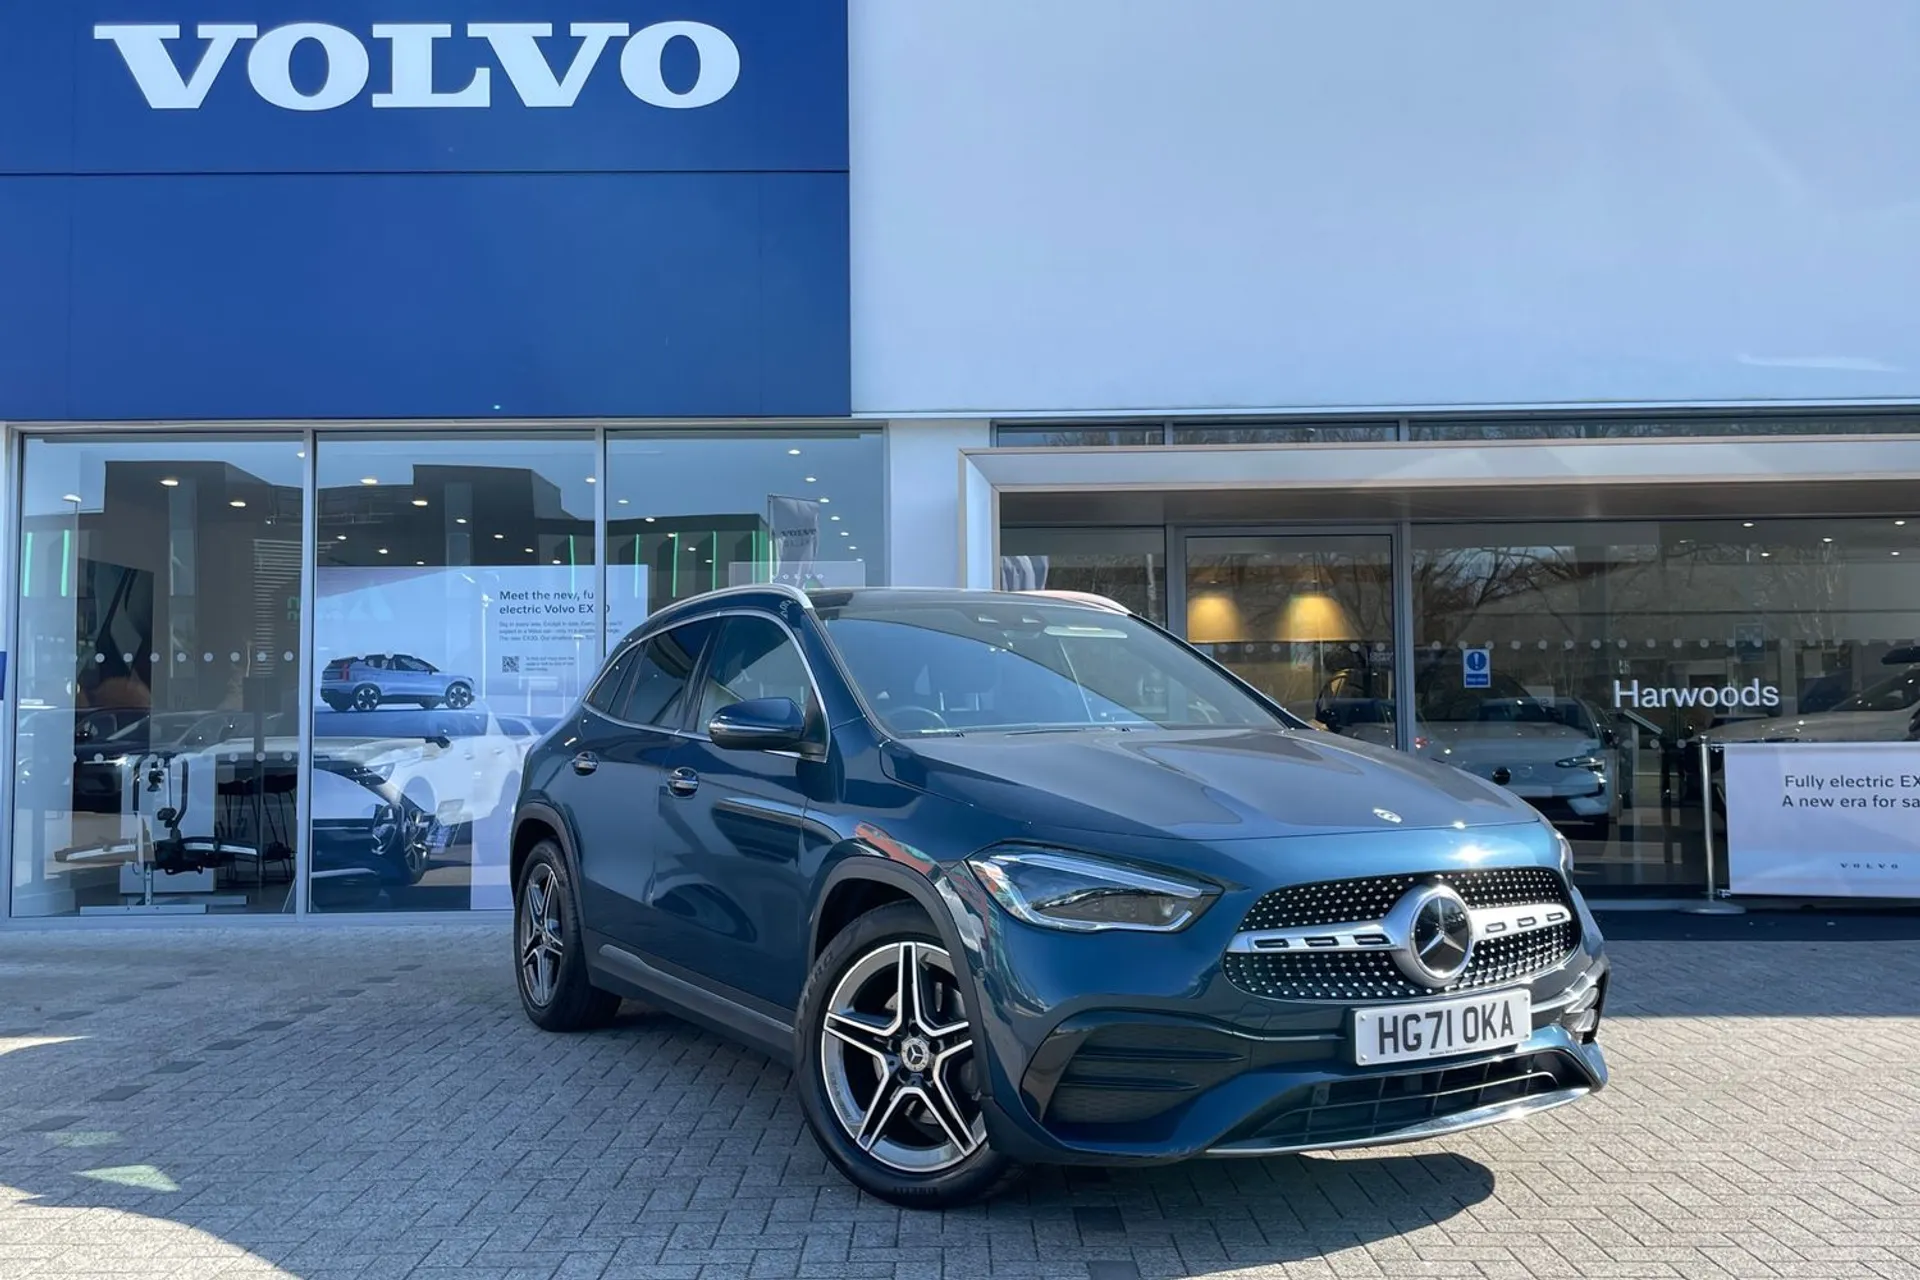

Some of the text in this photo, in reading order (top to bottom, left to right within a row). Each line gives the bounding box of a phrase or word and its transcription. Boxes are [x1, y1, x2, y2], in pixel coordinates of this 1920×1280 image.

[94, 20, 741, 111] VOLVO
[499, 591, 529, 600] Meet
[532, 590, 550, 600] the
[499, 604, 542, 614] electric
[544, 604, 575, 614] Volvo
[1614, 678, 1779, 707] Harwoods
[1784, 775, 1825, 790] Fully
[1830, 775, 1895, 788] electric
[1782, 795, 1794, 807] A
[1799, 797, 1834, 808] new
[1840, 797, 1867, 808] era
[1872, 794, 1896, 808] for
[1840, 862, 1899, 870] VOLVO
[1378, 1000, 1514, 1055] HG71 OKA
